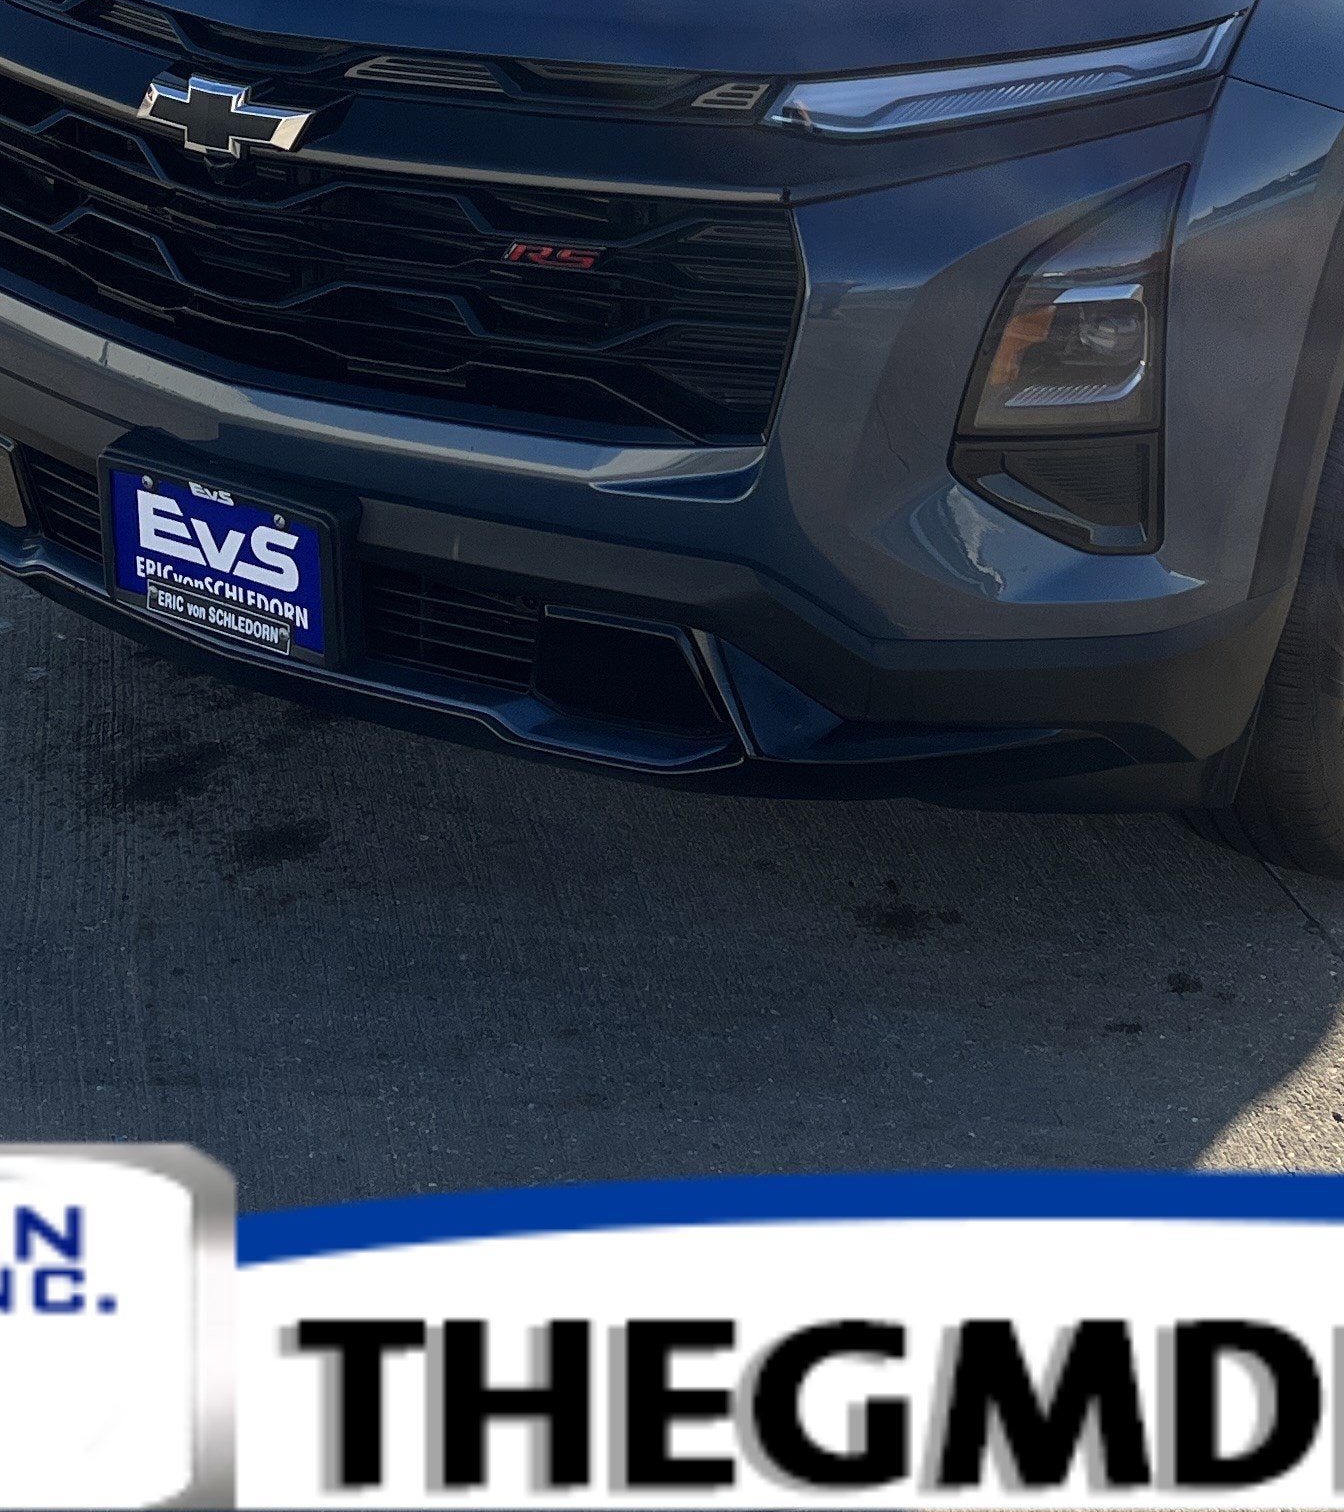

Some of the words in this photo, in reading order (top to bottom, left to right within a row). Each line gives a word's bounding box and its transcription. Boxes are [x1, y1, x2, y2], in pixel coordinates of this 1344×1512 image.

[506, 243, 600, 269] RS
[157, 590, 185, 613] ERIC
[186, 601, 207, 621] von
[208, 605, 280, 645] SCHLEDORN
